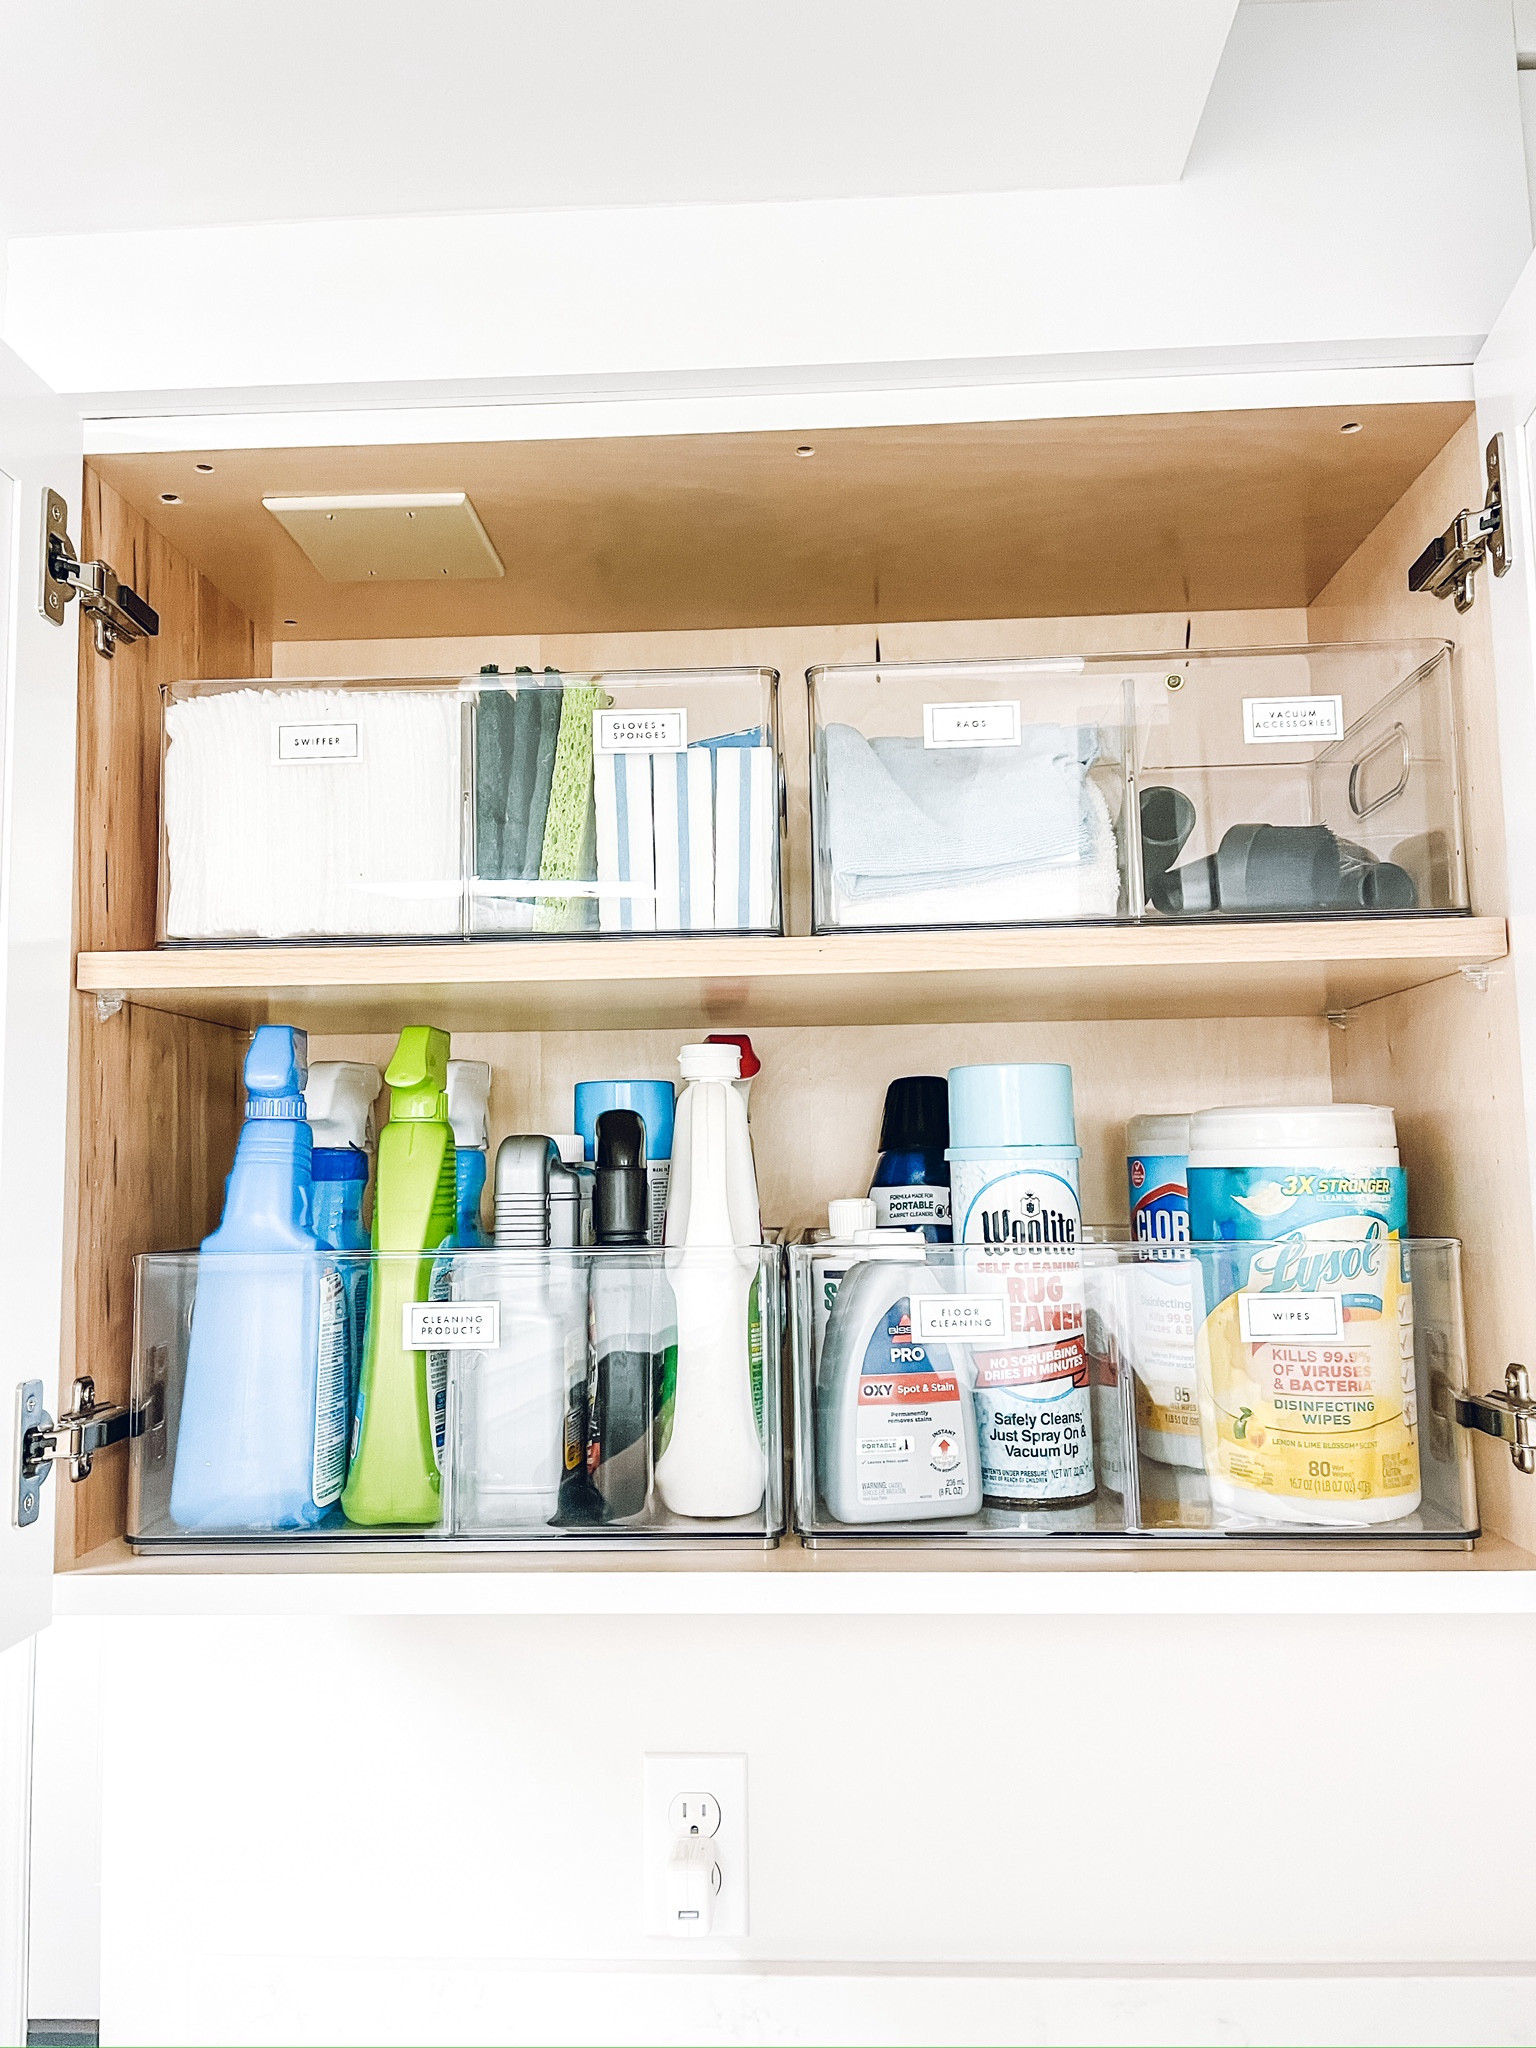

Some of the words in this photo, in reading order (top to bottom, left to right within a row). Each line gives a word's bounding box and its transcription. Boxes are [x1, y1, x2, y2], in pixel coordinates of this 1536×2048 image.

[1269, 710, 1316, 718] VACUUM
[613, 722, 656, 730] GLOVES
[956, 720, 986, 728] RAGS
[1255, 719, 1332, 728] ACCESSORIES
[294, 737, 340, 746] SWIFFER
[613, 731, 666, 739] SPONGES
[1281, 1175, 1315, 1196] 3X
[1317, 1178, 1391, 1194] STRONGER
[889, 1201, 934, 1211] PORTABLE
[981, 1209, 1076, 1252] Woolite
[1136, 1209, 1190, 1250] CLOR
[1254, 1222, 1381, 1292] Lysol
[977, 1262, 1010, 1273] SELF
[1014, 1261, 1080, 1274] CLEANING
[1006, 1276, 1063, 1303] RUG
[942, 1308, 979, 1316] FLOOR
[1009, 1303, 1083, 1332] EANER
[1272, 1312, 1310, 1321] WIPES
[422, 1315, 483, 1324] CLEANING
[930, 1318, 992, 1328] CLEANING
[421, 1326, 481, 1335] PRODUCTS
[888, 1325, 911, 1335] BISS
[890, 1347, 925, 1363] PRO
[990, 1358, 1008, 1369] NO
[1011, 1344, 1078, 1367] SCRUBBING
[1272, 1349, 1317, 1363] KILLS
[984, 1368, 1021, 1381] DRIES
[1023, 1366, 1038, 1377] IN
[1039, 1354, 1083, 1375] MINUTES
[1273, 1364, 1294, 1376] OF
[1301, 1365, 1372, 1378] VIRUSES
[863, 1383, 893, 1397] OXY
[897, 1384, 921, 1395] Spot
[921, 1384, 930, 1393] &
[931, 1382, 955, 1392] Stain
[1273, 1378, 1284, 1390] &
[1289, 1379, 1373, 1392] BACTERIA
[1174, 1386, 1190, 1402] 85
[1274, 1399, 1375, 1412] DISINFECTING
[891, 1410, 929, 1418] Permanently
[994, 1412, 1037, 1429] Safely
[1302, 1414, 1351, 1425] WIPES
[931, 1429, 956, 1438] INSTANT
[989, 1428, 1018, 1442] Just
[1021, 1429, 1061, 1445] Spray
[1063, 1427, 1079, 1440] On
[1080, 1424, 1086, 1438] &
[1272, 1438, 1296, 1447] LEMON
[1005, 1444, 1060, 1458] Vacuum
[1063, 1443, 1079, 1458] Up
[1308, 1460, 1331, 1477] 80
[1303, 1479, 1313, 1490] OZ
[1322, 1481, 1331, 1492] LB
